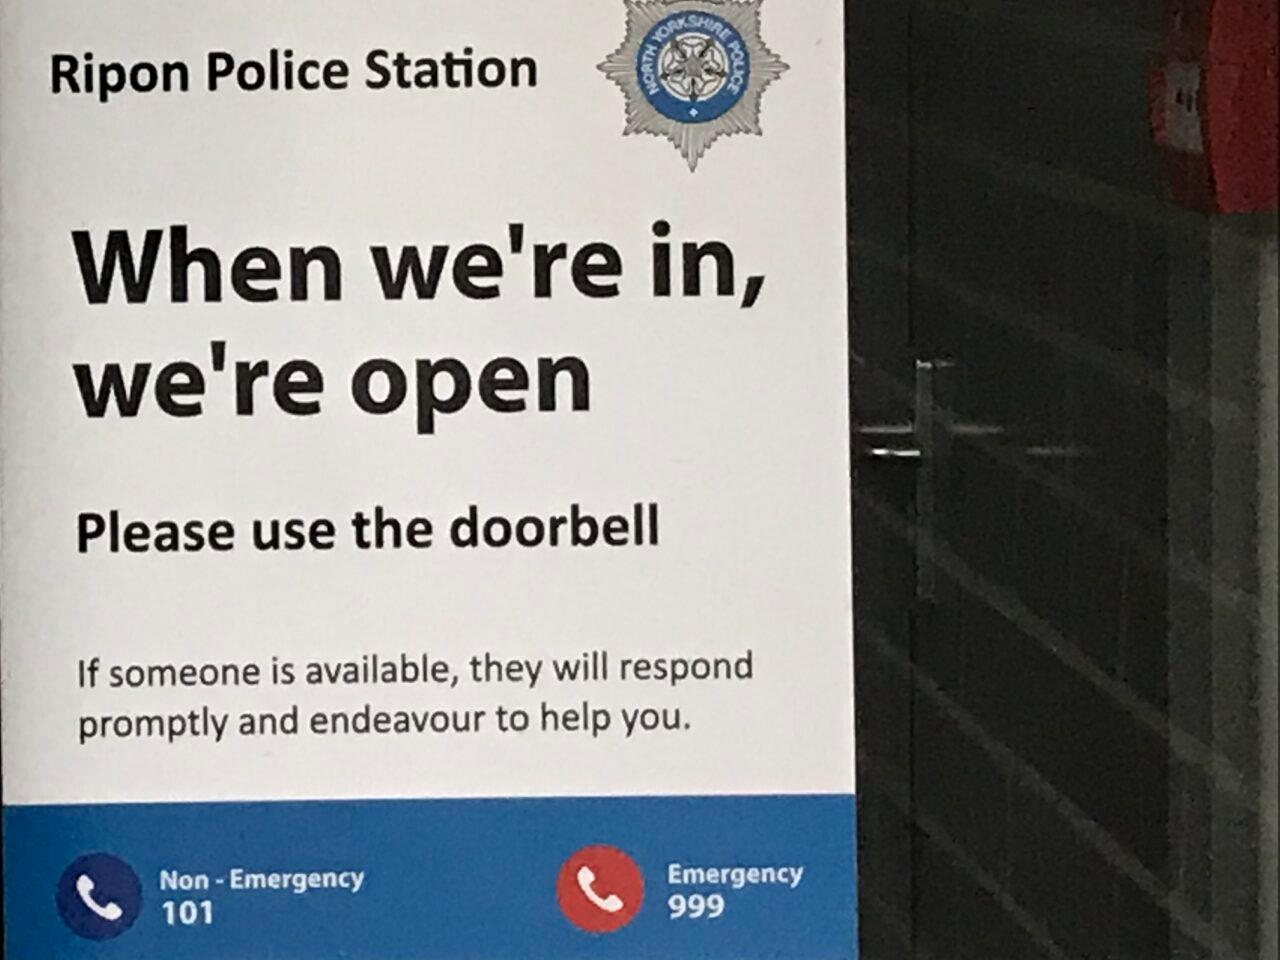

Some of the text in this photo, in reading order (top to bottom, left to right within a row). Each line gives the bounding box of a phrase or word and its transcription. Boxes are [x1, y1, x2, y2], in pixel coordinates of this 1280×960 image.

[51, 46, 536, 103] Ripon Police Station
[641, 15, 745, 95] NORTH YORKSHIRE POLICE
[71, 218, 765, 310] When we're in,
[73, 340, 589, 434] we're open
[78, 502, 658, 553] Please use the doorbell
[78, 649, 752, 689] If someone is available, they will respond
[79, 700, 689, 745] promptly and endeavour to help you.
[160, 869, 209, 890] Non
[230, 866, 364, 894] Emergency
[668, 861, 803, 889] Emergency
[162, 900, 212, 925] 101
[668, 893, 724, 919] 999
